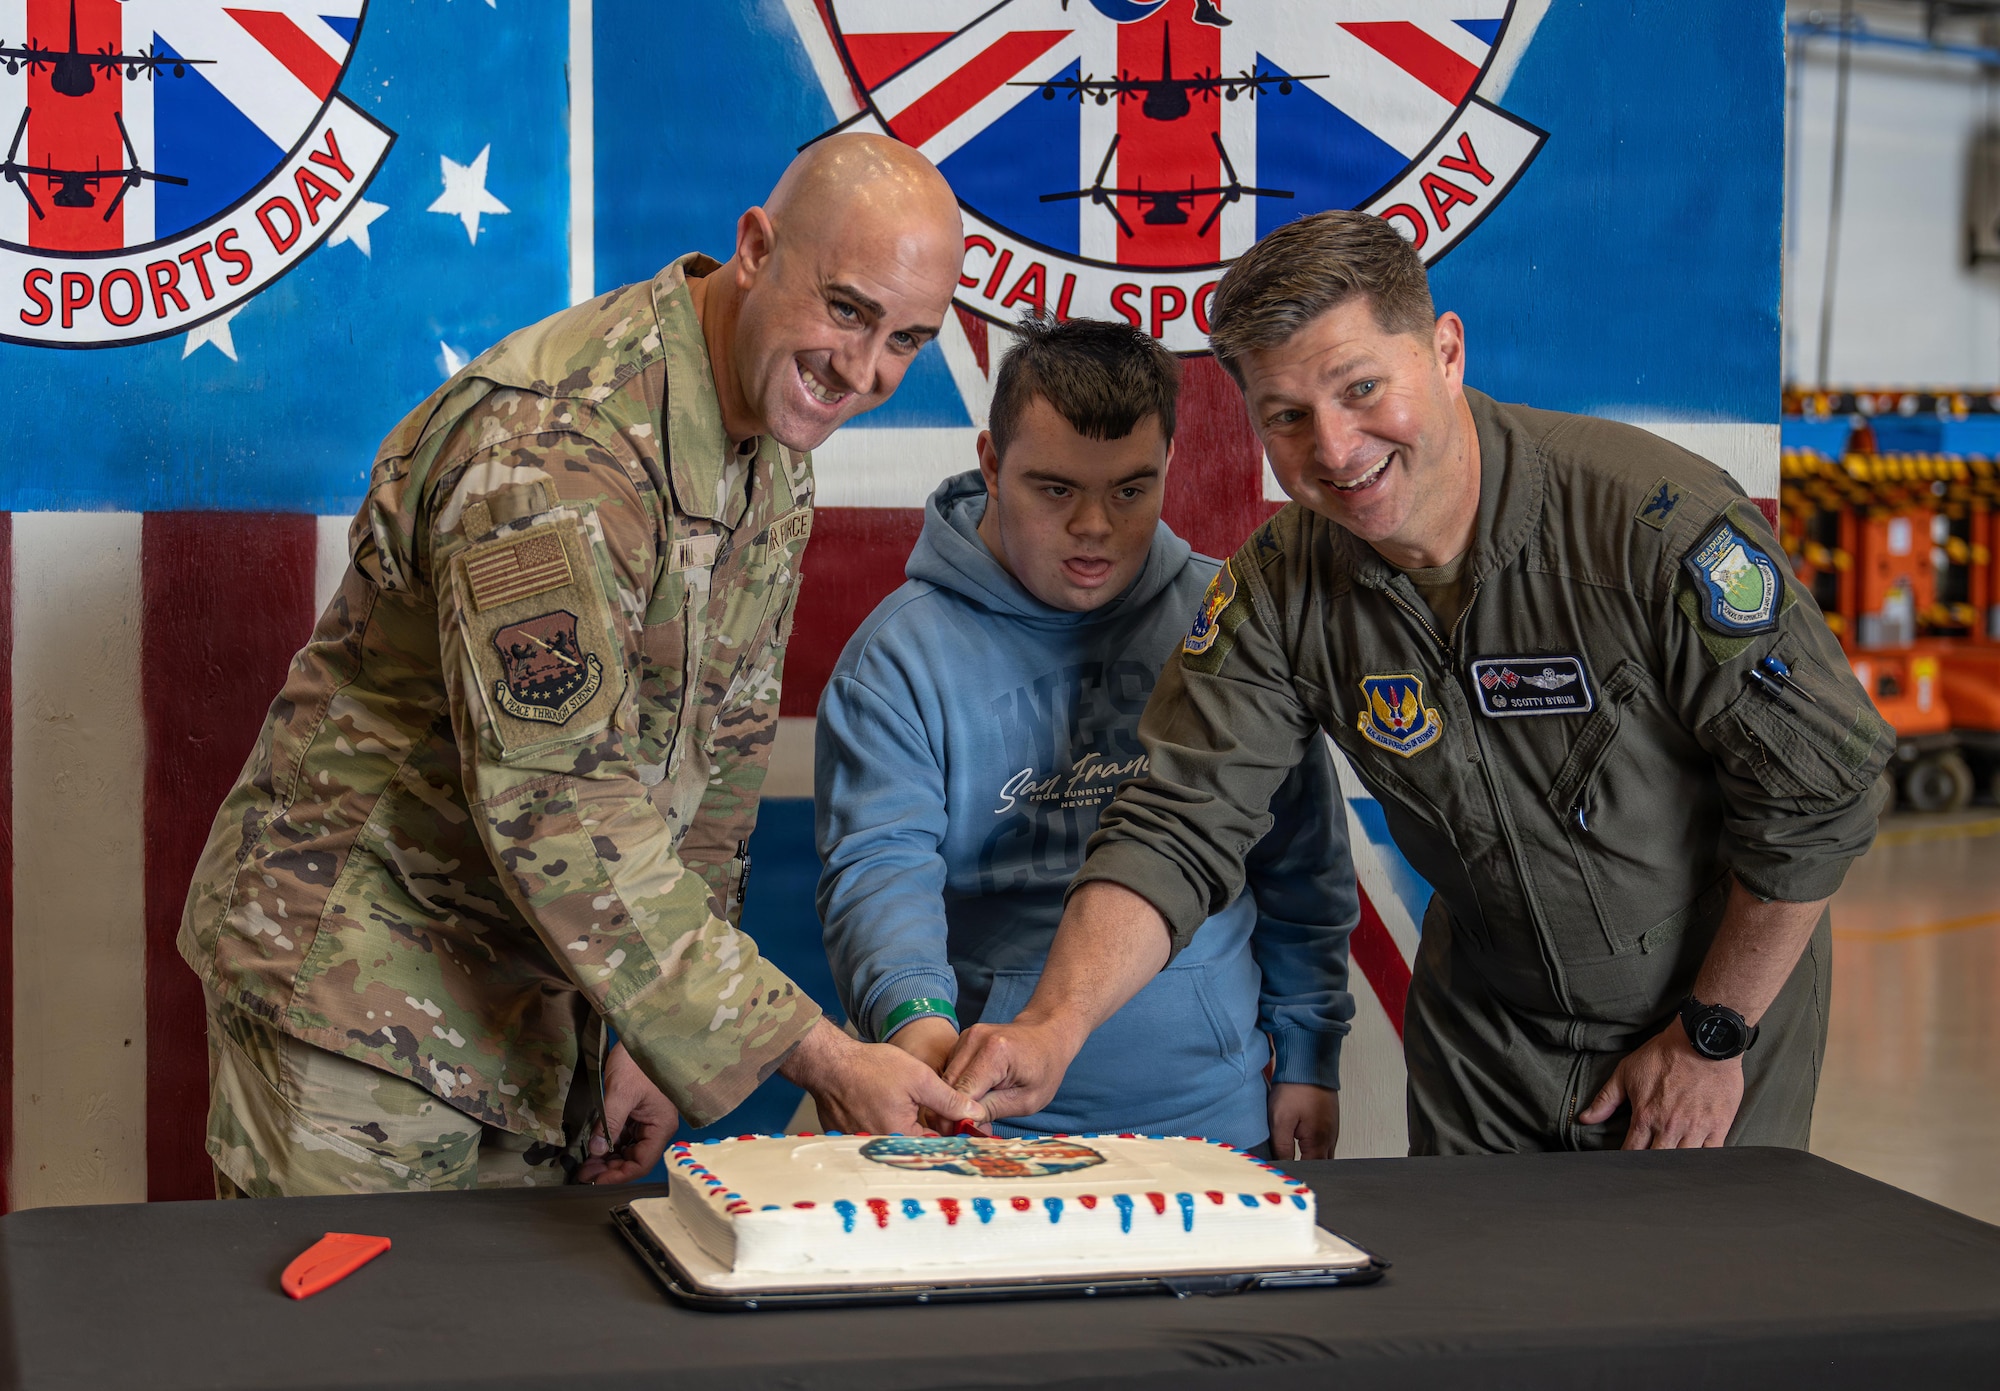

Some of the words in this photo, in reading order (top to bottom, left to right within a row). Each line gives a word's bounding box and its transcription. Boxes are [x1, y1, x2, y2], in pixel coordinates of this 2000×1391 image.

[19, 228, 253, 329] SPORTS
[254, 127, 355, 256] DAY
[958, 233, 1077, 325] CIAL
[1110, 280, 1219, 339] SPO
[1379, 131, 1495, 251] DAY
[1696, 527, 1730, 563] GRADUATE
[504, 697, 530, 718] PEACE
[532, 705, 570, 721] THROUGH
[569, 673, 599, 709] STRENGTH
[1510, 697, 1543, 708] SCOTTY
[1545, 695, 1576, 705] BYRUM
[1375, 736, 1388, 745] AIR
[1388, 739, 1412, 752] FORCES
[1410, 738, 1418, 748] IN
[1417, 723, 1437, 744] EUROPE
[994, 767, 1062, 814] San
[1029, 792, 1060, 802] FROM
[1064, 786, 1114, 799] SUNRISE
[1060, 798, 1102, 809] NEVER
